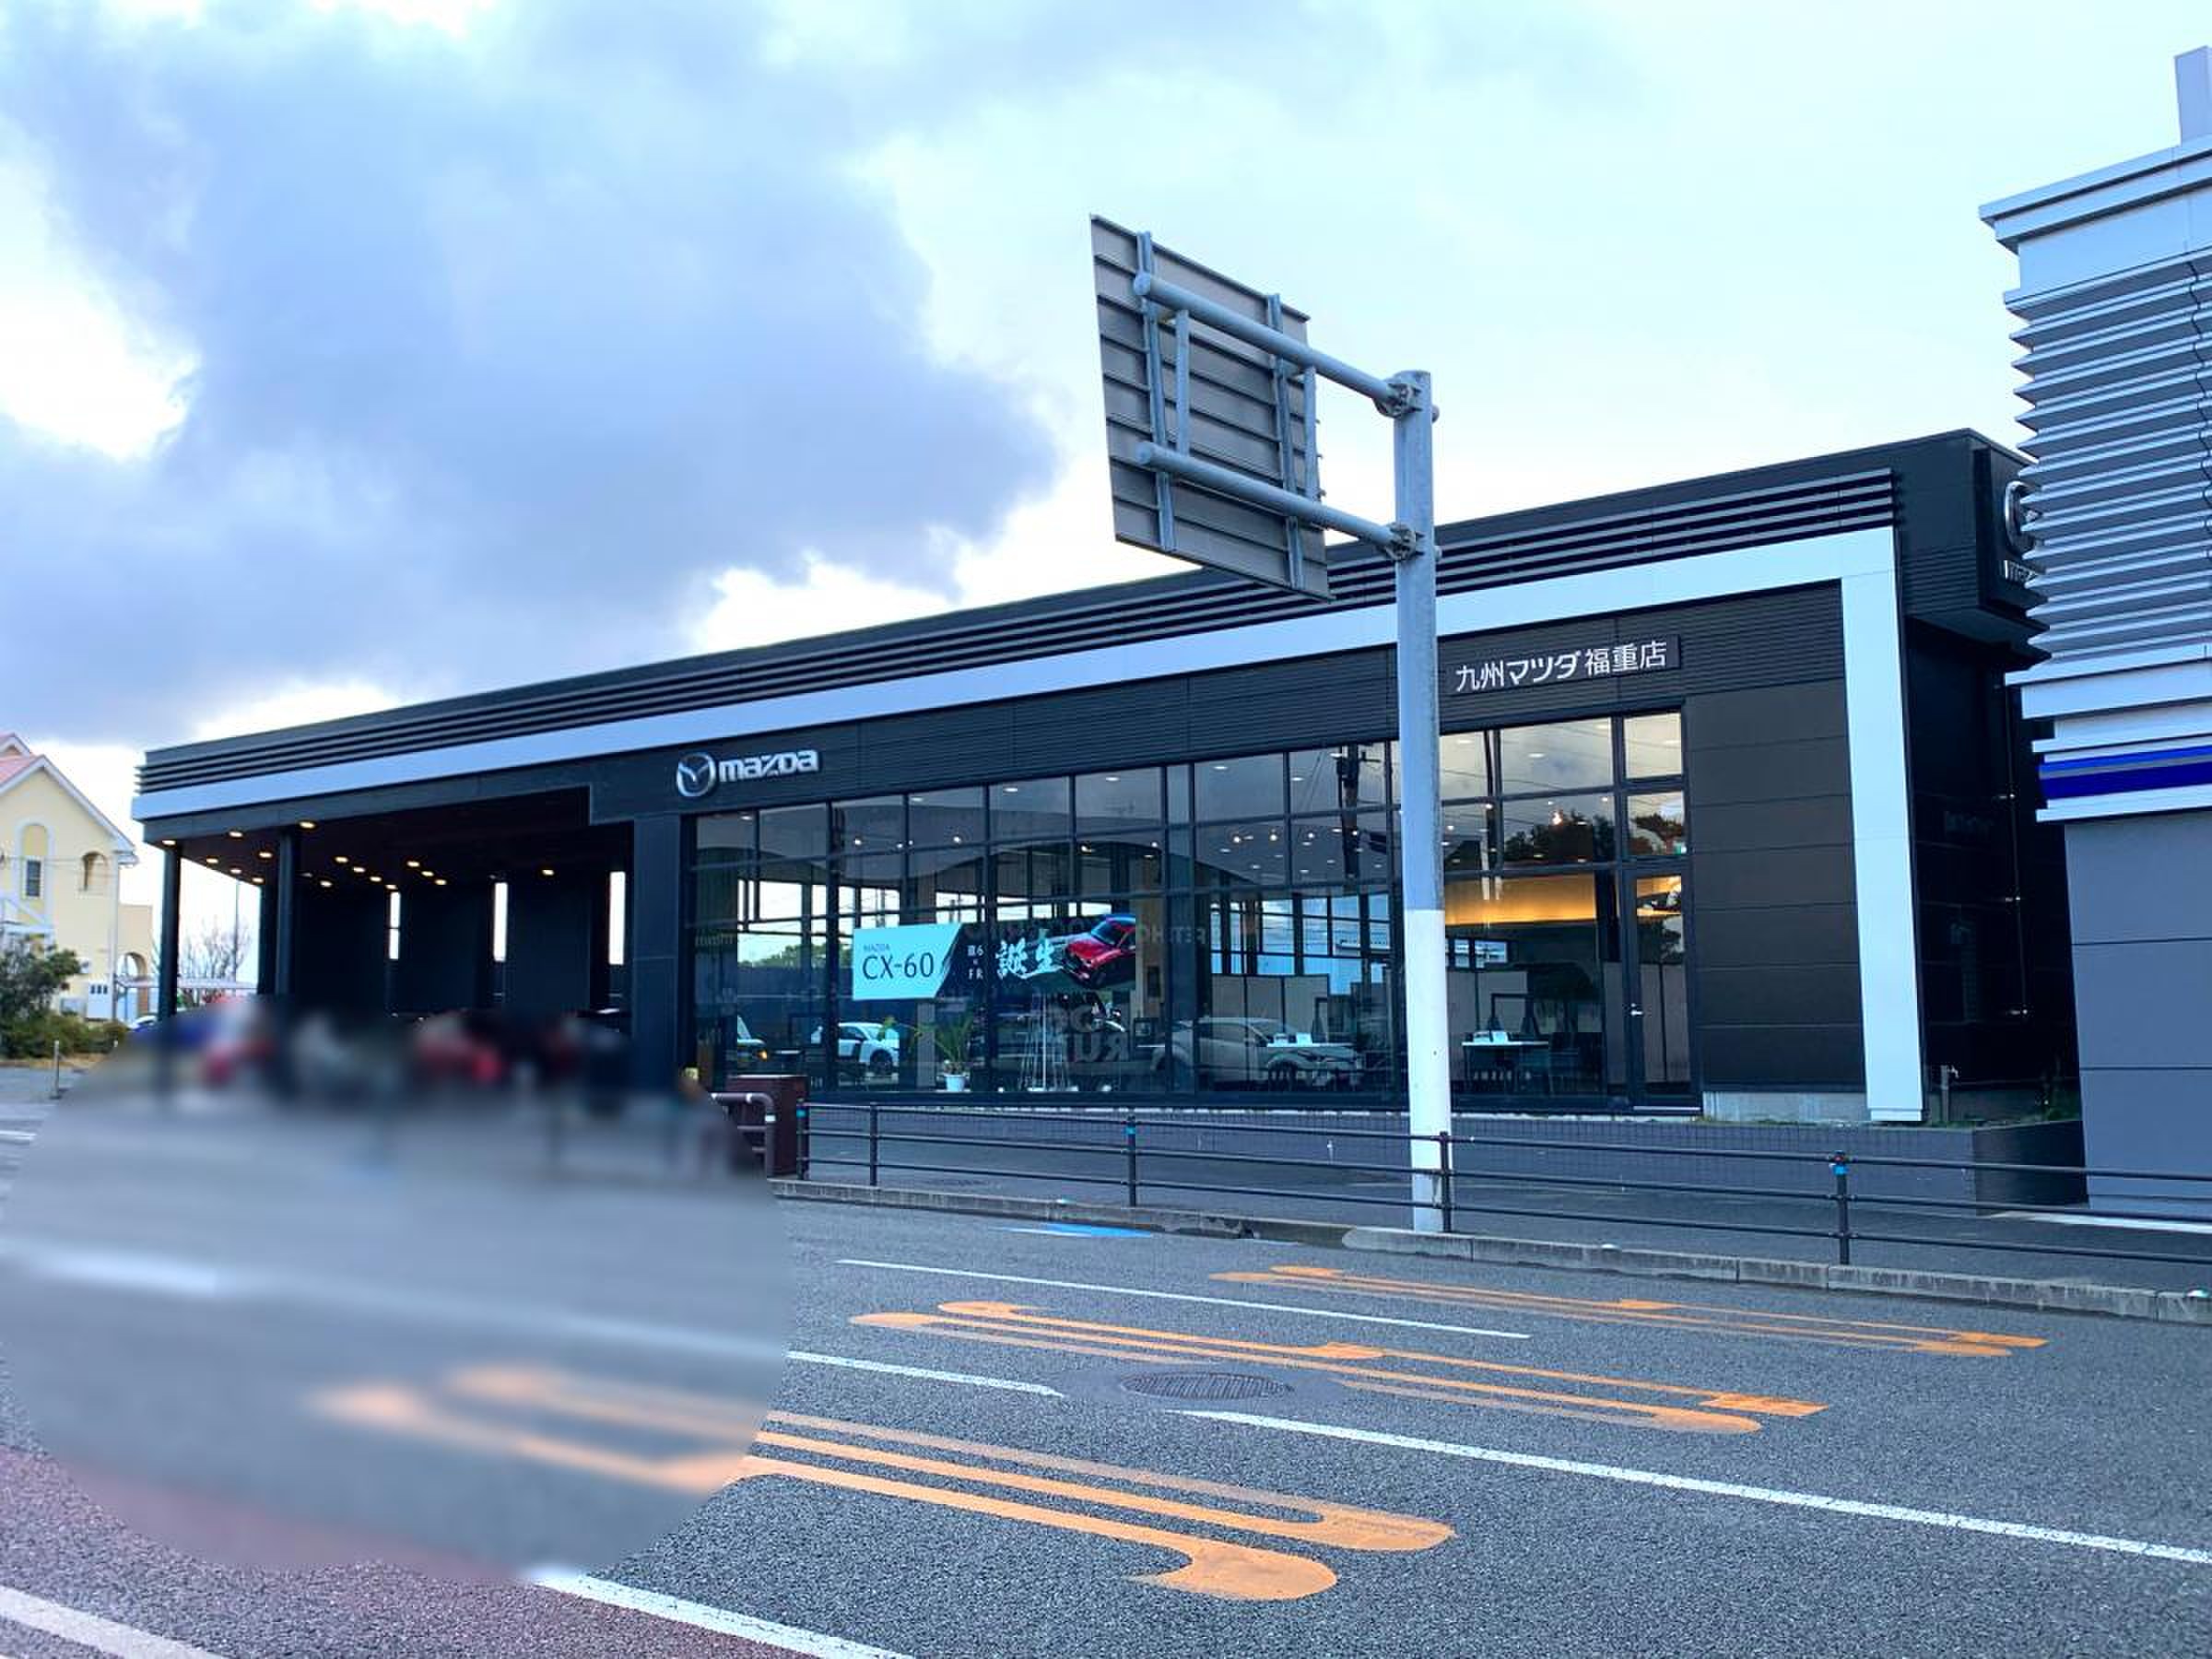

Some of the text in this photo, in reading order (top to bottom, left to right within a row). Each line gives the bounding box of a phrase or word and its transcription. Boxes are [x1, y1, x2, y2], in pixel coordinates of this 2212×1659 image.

[1455, 640, 1668, 692] 九州マツダ福重店
[862, 951, 935, 981] CX-60
